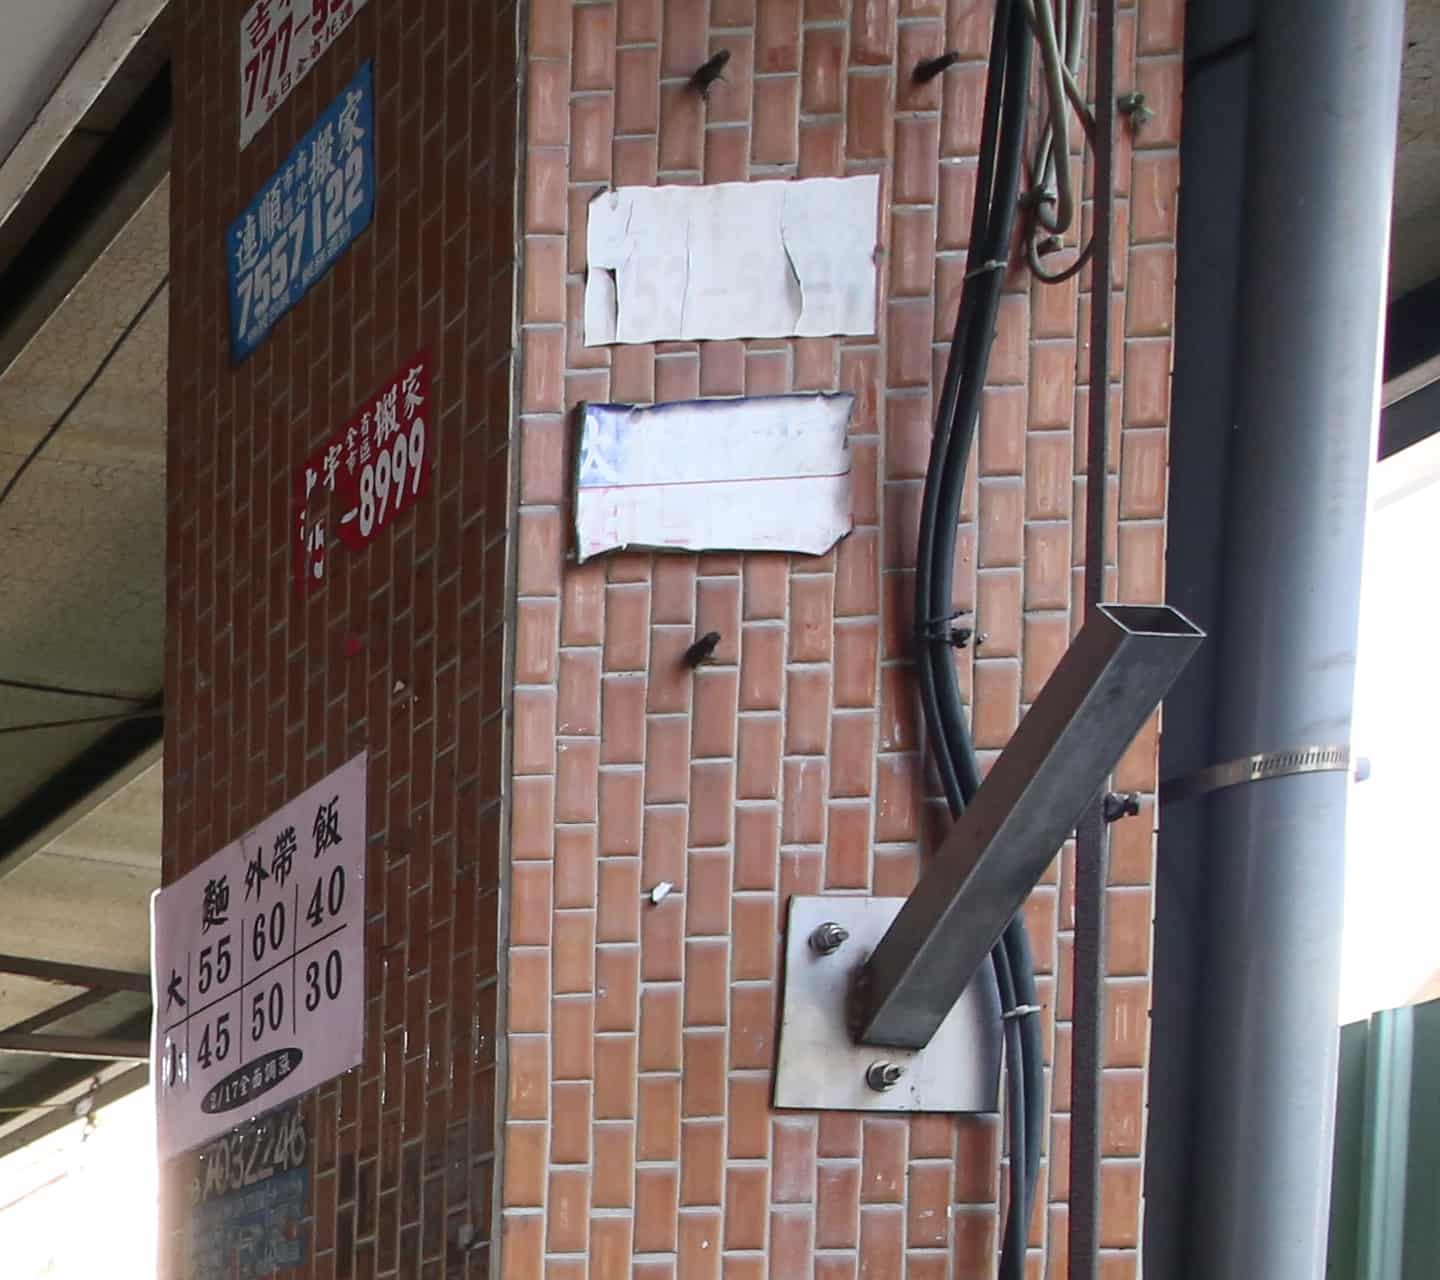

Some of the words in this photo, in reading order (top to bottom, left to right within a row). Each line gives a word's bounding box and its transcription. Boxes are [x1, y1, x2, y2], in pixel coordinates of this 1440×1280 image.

[237, 146, 364, 338] 7557122
[244, 826, 297, 902] 外帶
[313, 795, 343, 860] 飯
[166, 969, 186, 1014] 大
[198, 934, 231, 995] 55
[252, 901, 285, 962] 60
[306, 865, 345, 928] 40
[197, 1012, 230, 1071] 45
[251, 981, 283, 1043] 50
[305, 949, 343, 1012] 30
